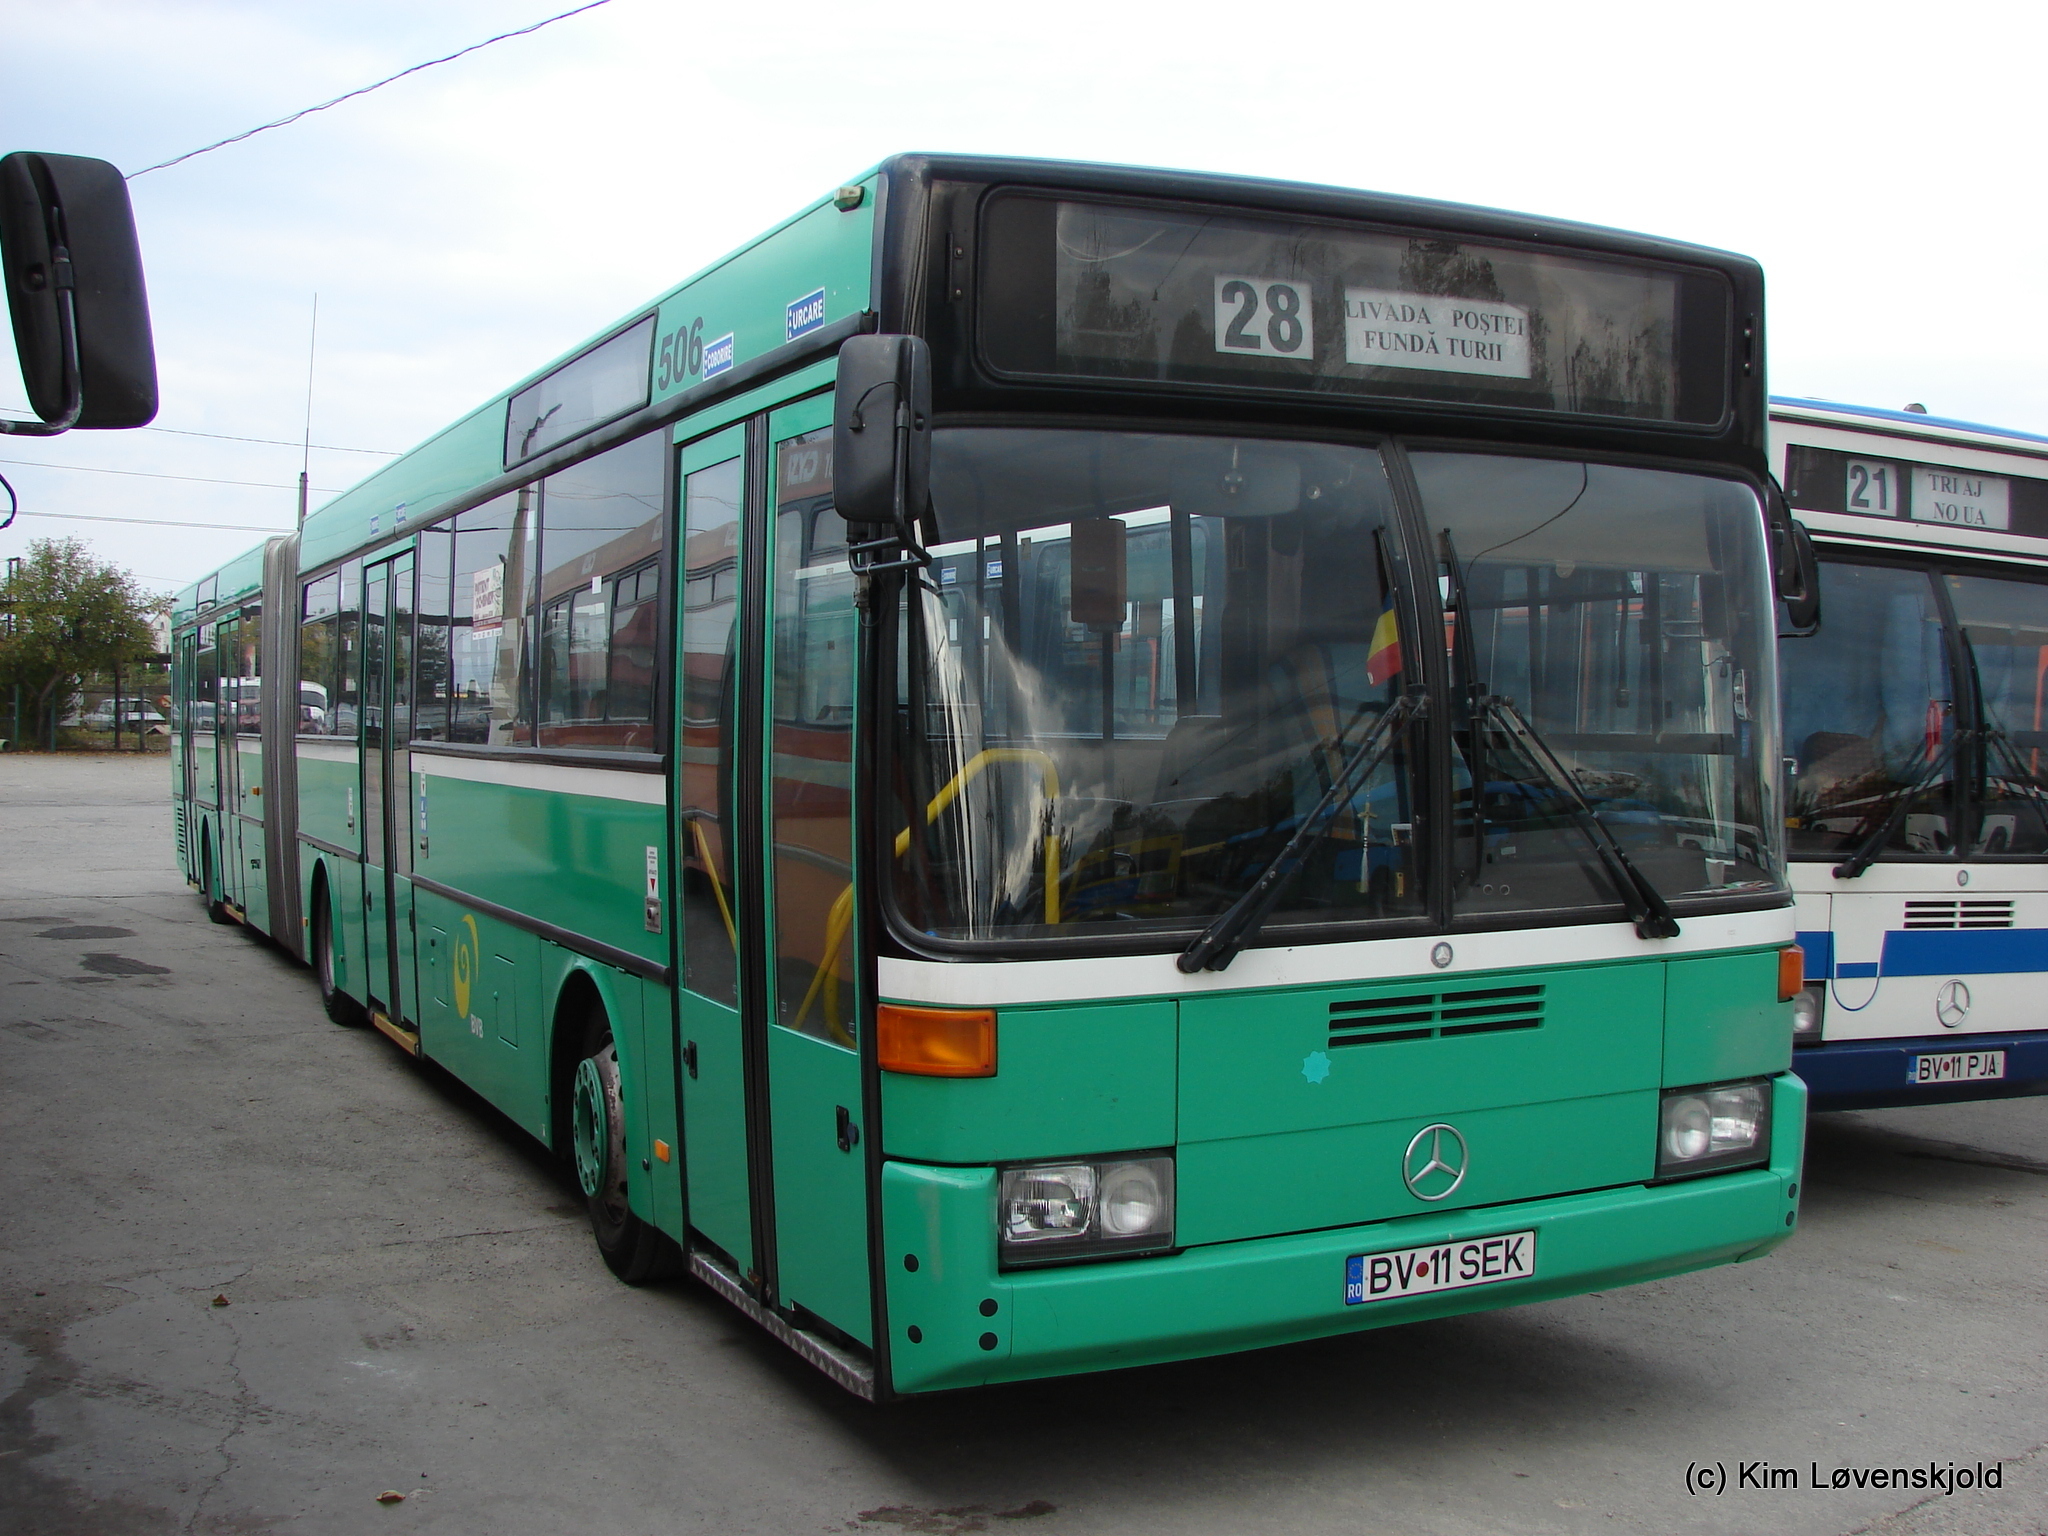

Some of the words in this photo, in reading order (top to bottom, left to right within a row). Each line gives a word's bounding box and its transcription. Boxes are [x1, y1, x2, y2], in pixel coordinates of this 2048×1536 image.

[792, 299, 823, 330] URCARE
[1221, 280, 1303, 353] 28
[1345, 299, 1431, 325] LIVADA
[658, 316, 704, 391] 506
[1364, 329, 1440, 355] FUNDĂ
[1446, 337, 1502, 362] TURII
[1850, 464, 1887, 511] 21
[1967, 1054, 1996, 1077] PJA
[1459, 1236, 1524, 1280] SEK
[1348, 1283, 1362, 1298] RO
